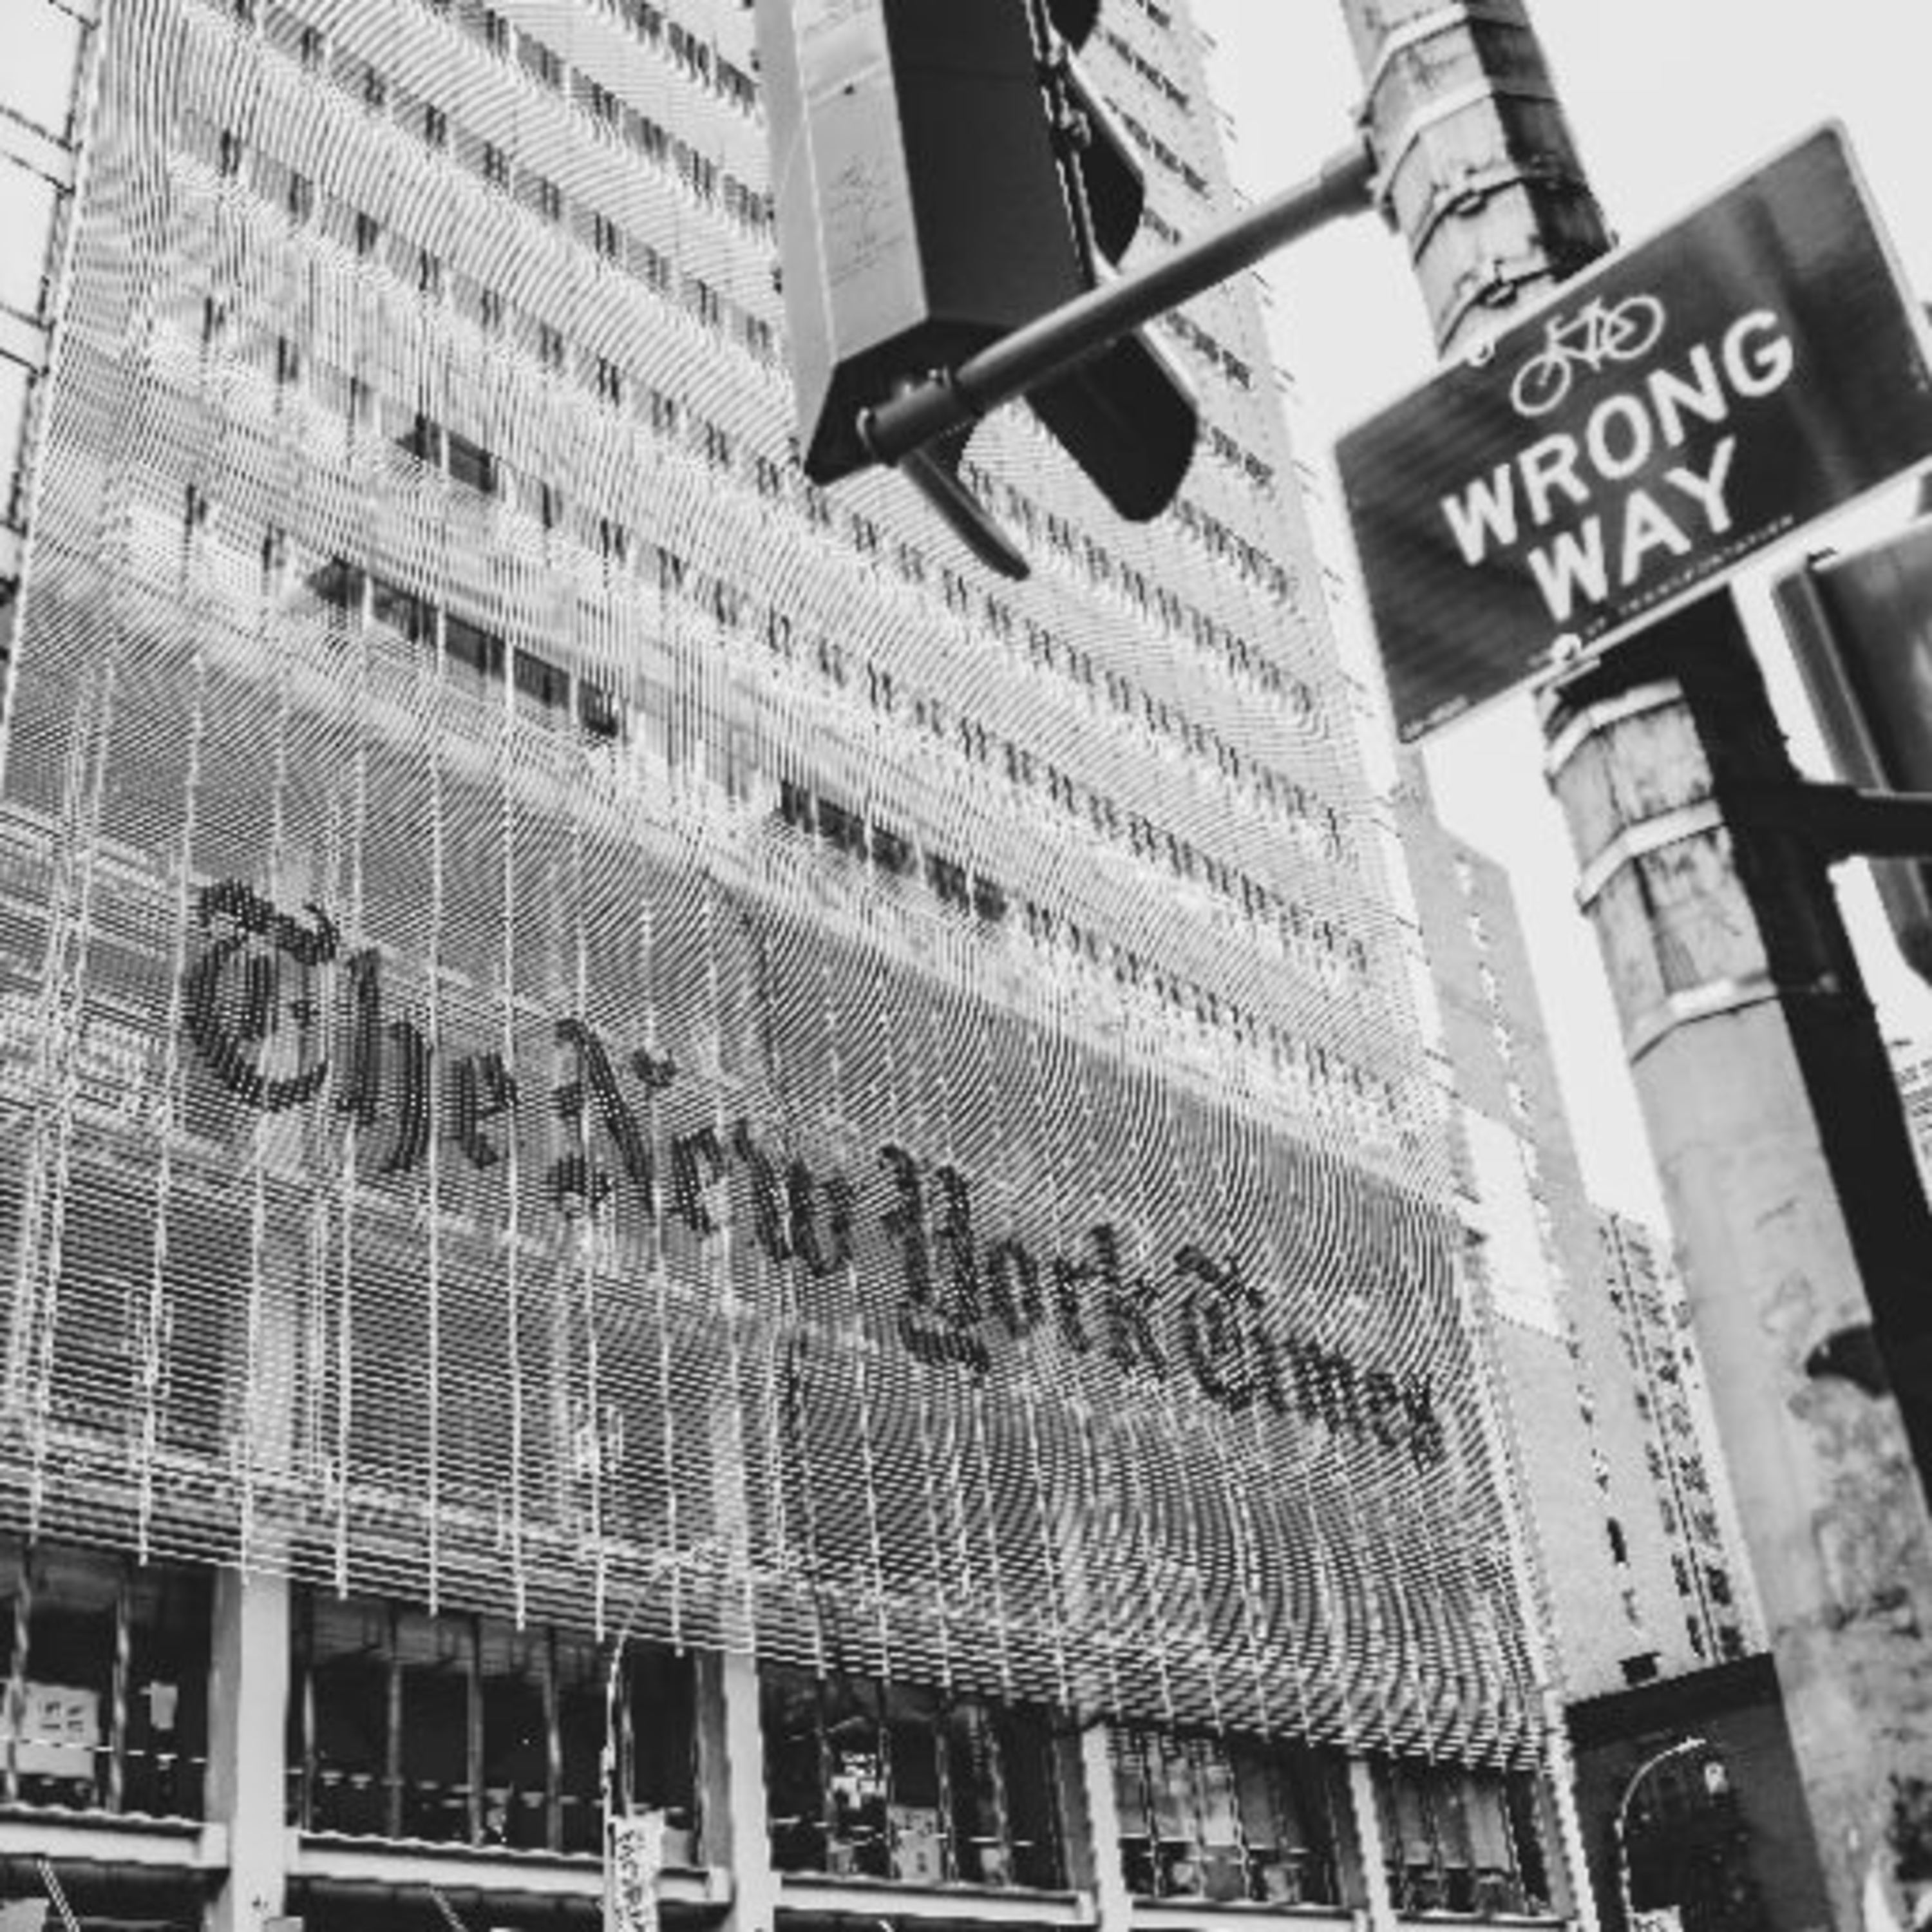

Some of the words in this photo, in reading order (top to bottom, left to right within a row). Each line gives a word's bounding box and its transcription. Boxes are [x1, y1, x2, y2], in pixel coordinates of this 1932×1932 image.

[1441, 309, 1793, 566] WRONG
[1526, 437, 1736, 622] WAY
[184, 878, 517, 1173] The
[547, 1016, 853, 1280] New
[878, 1143, 1166, 1380] York
[1173, 1245, 1446, 1467] Times
